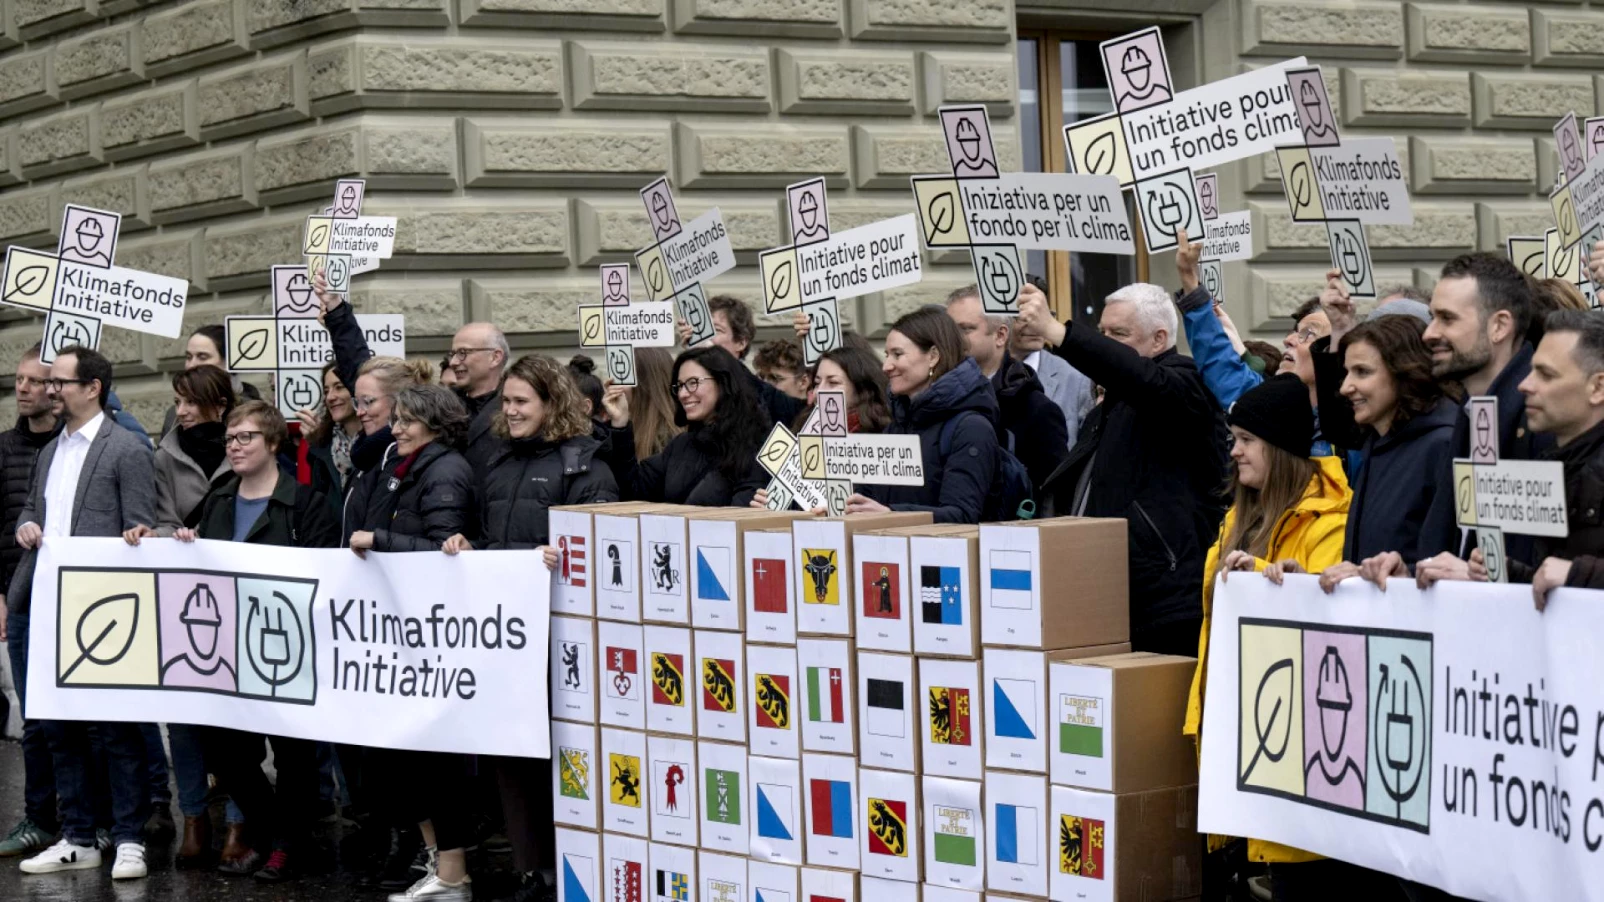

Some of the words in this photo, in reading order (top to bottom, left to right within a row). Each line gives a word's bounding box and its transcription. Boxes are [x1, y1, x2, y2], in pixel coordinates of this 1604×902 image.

[1128, 101, 1233, 145] Initiative
[1135, 146, 1166, 171] un
[1169, 122, 1239, 162] fonds
[1314, 152, 1401, 182] Klimafonds
[964, 186, 1048, 212] Iniziativa
[1053, 192, 1082, 217] per
[1086, 192, 1110, 213] un
[1321, 184, 1390, 212] Initiative
[333, 222, 394, 238] Klimafonds
[664, 220, 725, 267] Klimafonds
[970, 213, 1027, 236] fondo
[1031, 218, 1062, 243] per
[1065, 216, 1078, 239] il
[1081, 218, 1130, 242] clima
[1206, 219, 1250, 239] limafonds
[330, 237, 379, 252] Initiative
[799, 242, 865, 274] Initiative
[869, 231, 906, 257] pour
[670, 249, 720, 287] Initiative
[802, 279, 822, 296] un
[825, 266, 868, 290] fonds
[872, 253, 919, 281] climat
[61, 265, 184, 309] Klimafonds
[57, 286, 154, 324] Initiative
[606, 309, 672, 326] Klimafonds
[282, 324, 403, 342] Klimnds
[607, 326, 659, 341] Initiative
[825, 441, 875, 458] Iniziativa
[878, 446, 896, 460] per
[898, 446, 913, 459] un
[827, 459, 859, 475] fondo
[861, 462, 880, 478] per
[882, 460, 891, 476] il
[892, 461, 923, 477] clima
[781, 462, 819, 508] Initiative
[1476, 472, 1523, 496] Initiative
[1525, 480, 1553, 499] pour
[1477, 502, 1490, 518] un
[1493, 497, 1524, 522] fonds
[1527, 500, 1564, 524] climat
[329, 597, 527, 650] Klimafonds
[332, 646, 477, 700] Initiative
[1445, 665, 1580, 759] Initiative
[1443, 763, 1478, 818] un
[1488, 753, 1571, 844] fonds
